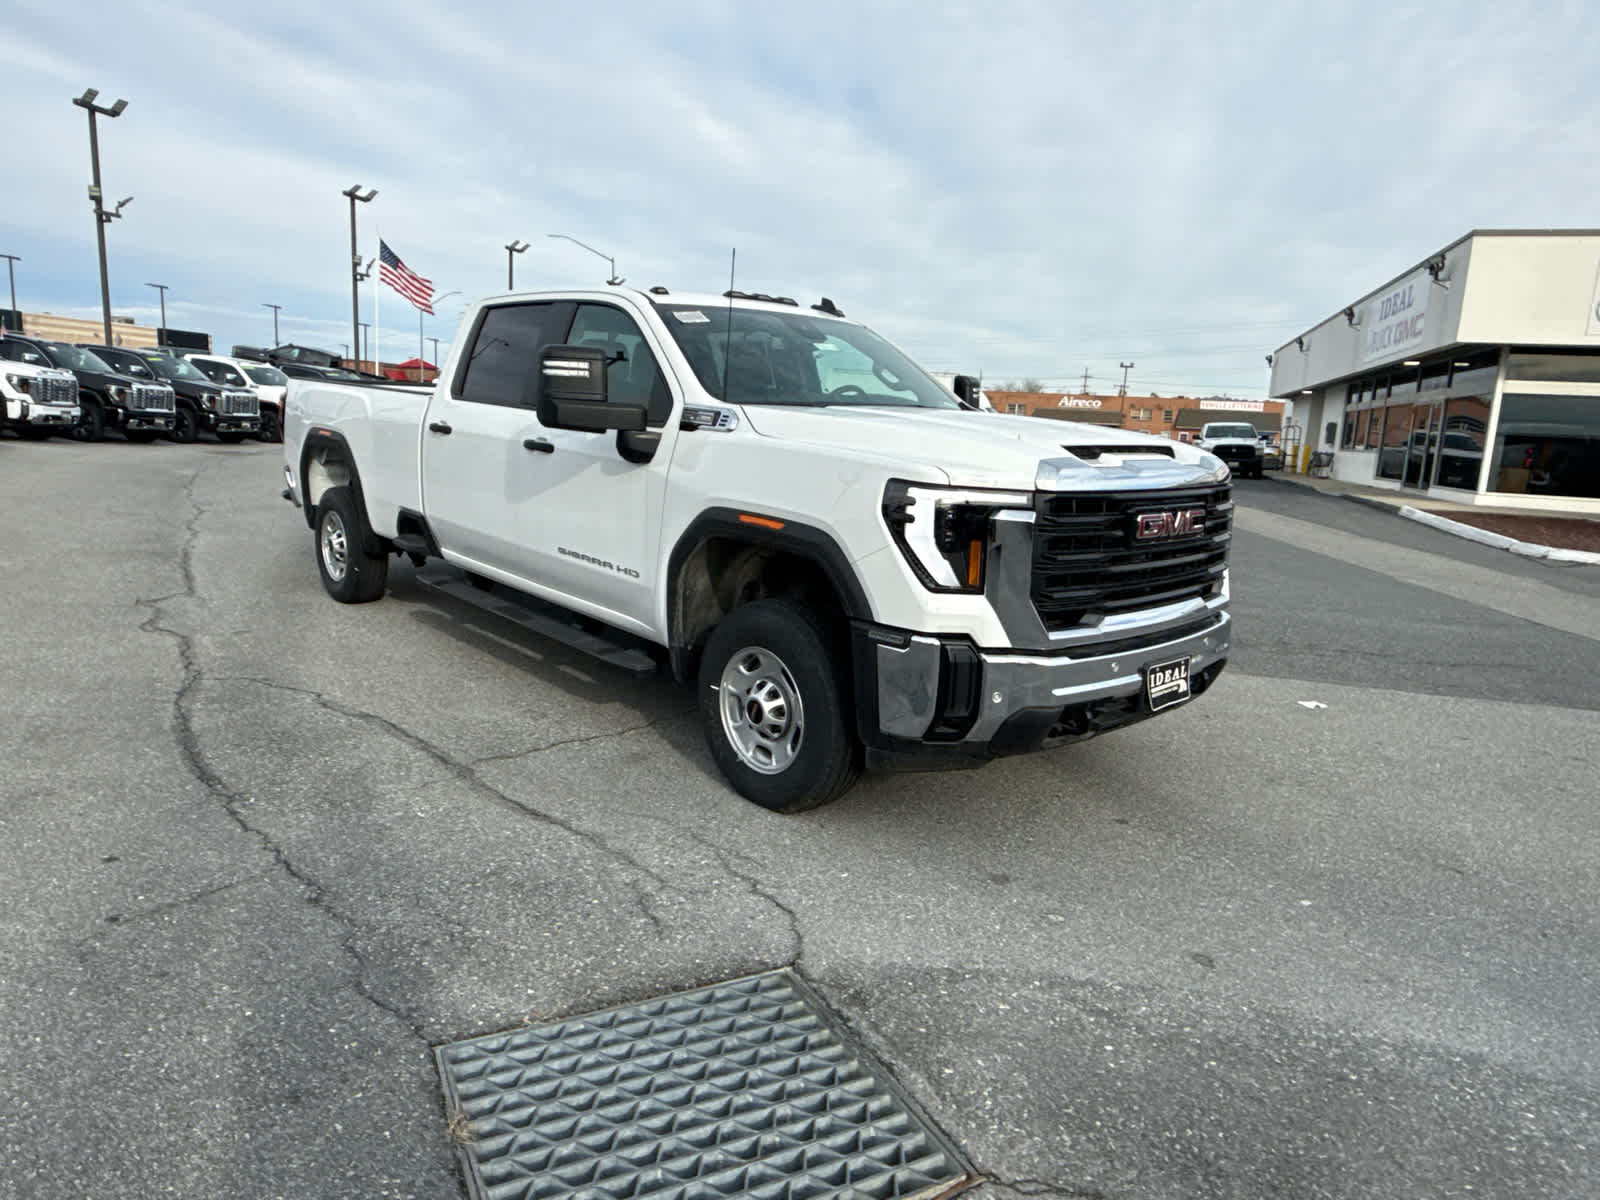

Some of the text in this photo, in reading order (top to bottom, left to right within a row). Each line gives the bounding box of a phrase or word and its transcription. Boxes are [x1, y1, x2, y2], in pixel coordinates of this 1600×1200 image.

[1379, 284, 1414, 321] IDEAL
[1058, 395, 1102, 408] Aireco
[1136, 509, 1206, 539] GMC
[557, 546, 640, 579] SIERRA HD
[1150, 665, 1187, 688] IDEAL
